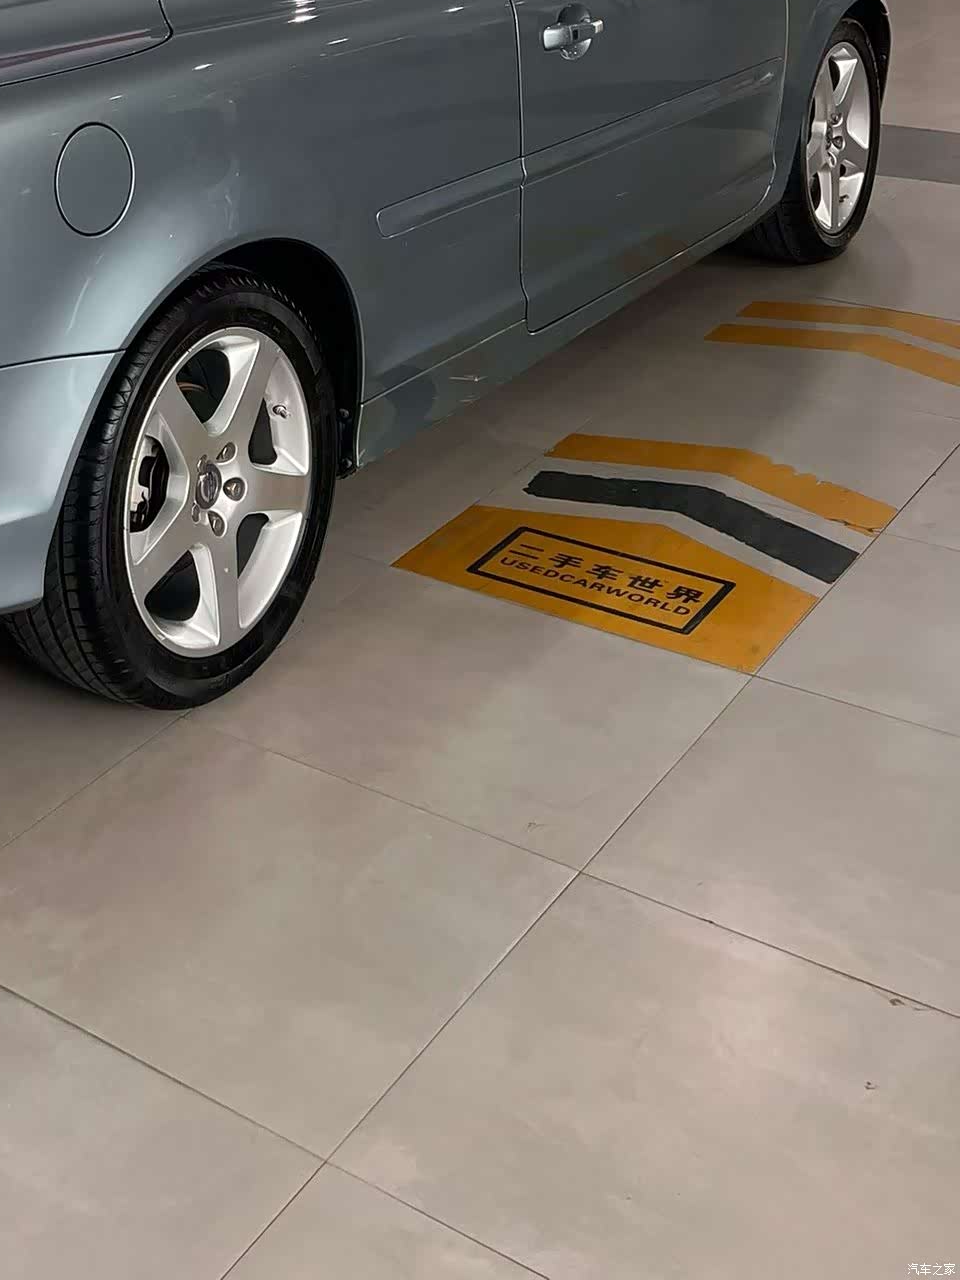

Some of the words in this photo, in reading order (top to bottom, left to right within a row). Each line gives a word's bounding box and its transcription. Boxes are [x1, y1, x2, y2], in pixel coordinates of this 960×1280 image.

[500, 556, 692, 617] USEDCARWORLD
[507, 543, 707, 604] 二手车世界
